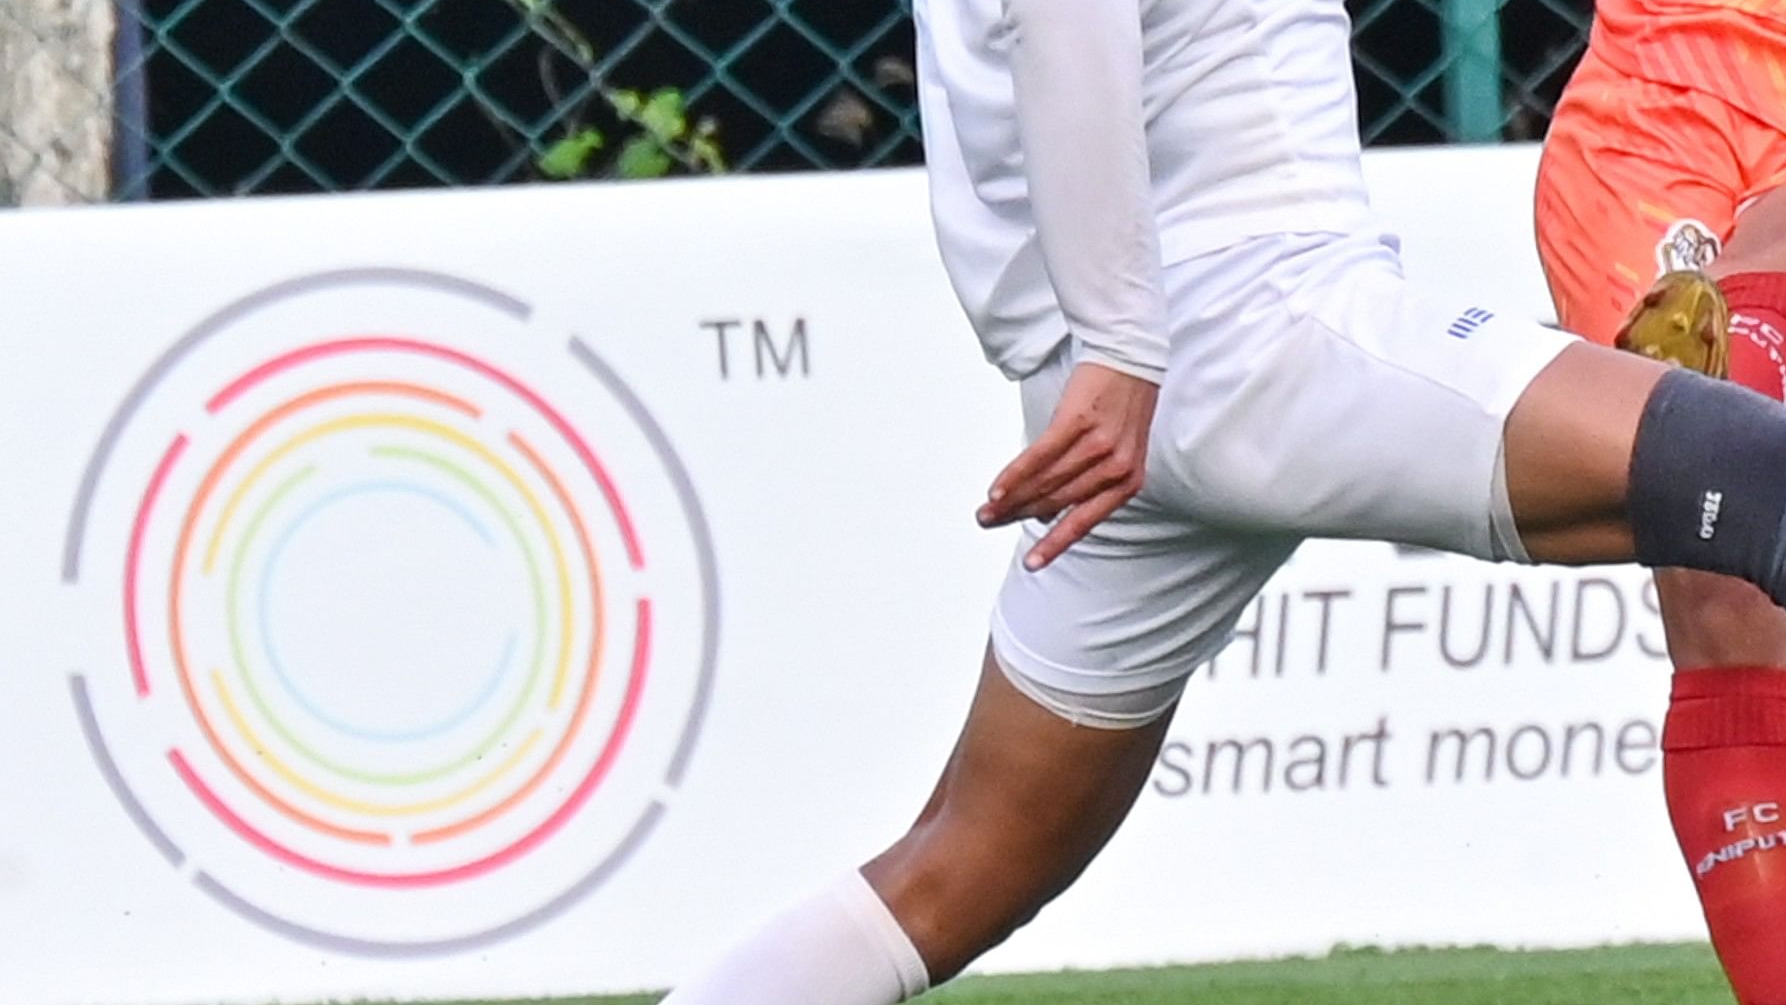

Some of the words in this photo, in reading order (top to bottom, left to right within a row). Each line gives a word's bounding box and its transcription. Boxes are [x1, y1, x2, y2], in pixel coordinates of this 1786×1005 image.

[698, 317, 810, 381] TM
[1206, 590, 1351, 681] HIT
[1152, 716, 1393, 797] smart
[1424, 718, 1658, 785] mone
[1723, 802, 1780, 832] FC
